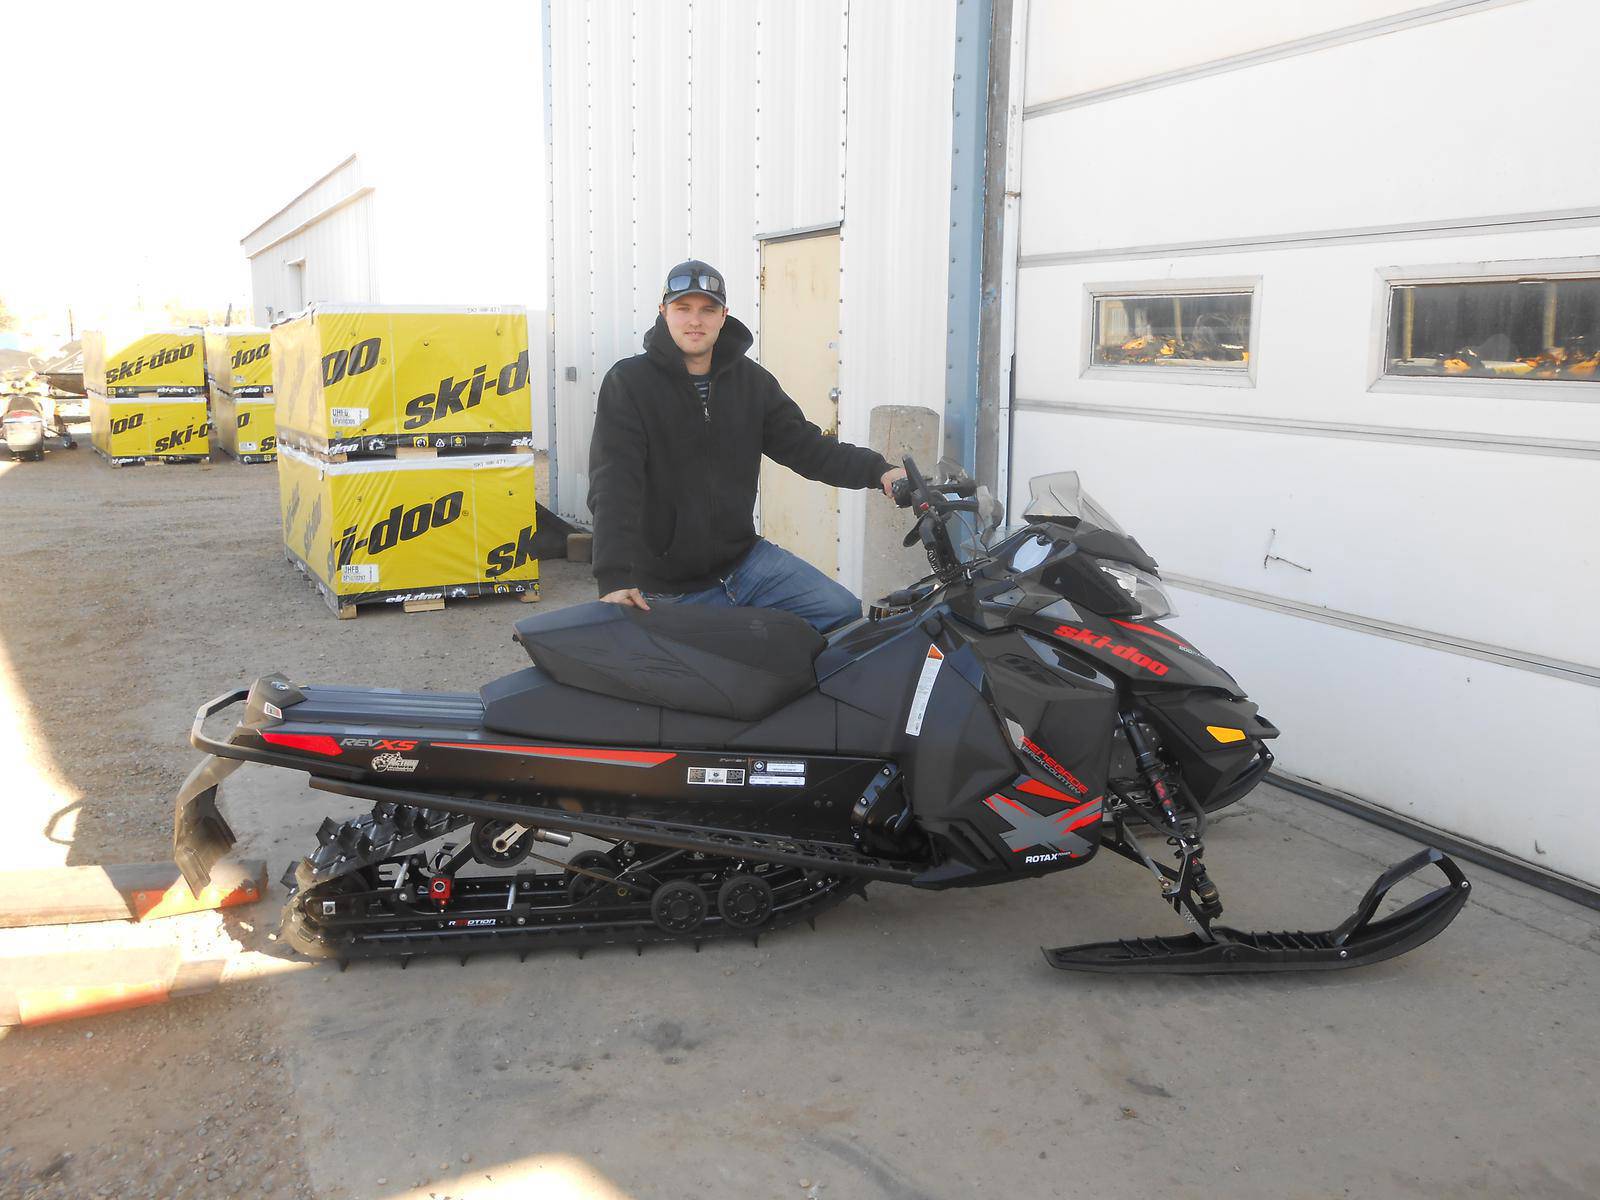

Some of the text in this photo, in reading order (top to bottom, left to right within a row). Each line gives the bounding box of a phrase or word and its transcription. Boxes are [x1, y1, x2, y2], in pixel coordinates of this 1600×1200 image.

[106, 343, 194, 384] ski-doo
[404, 350, 532, 429] ski-d
[1053, 625, 1169, 676] ski-doo
[1025, 853, 1058, 863] ROTAX
